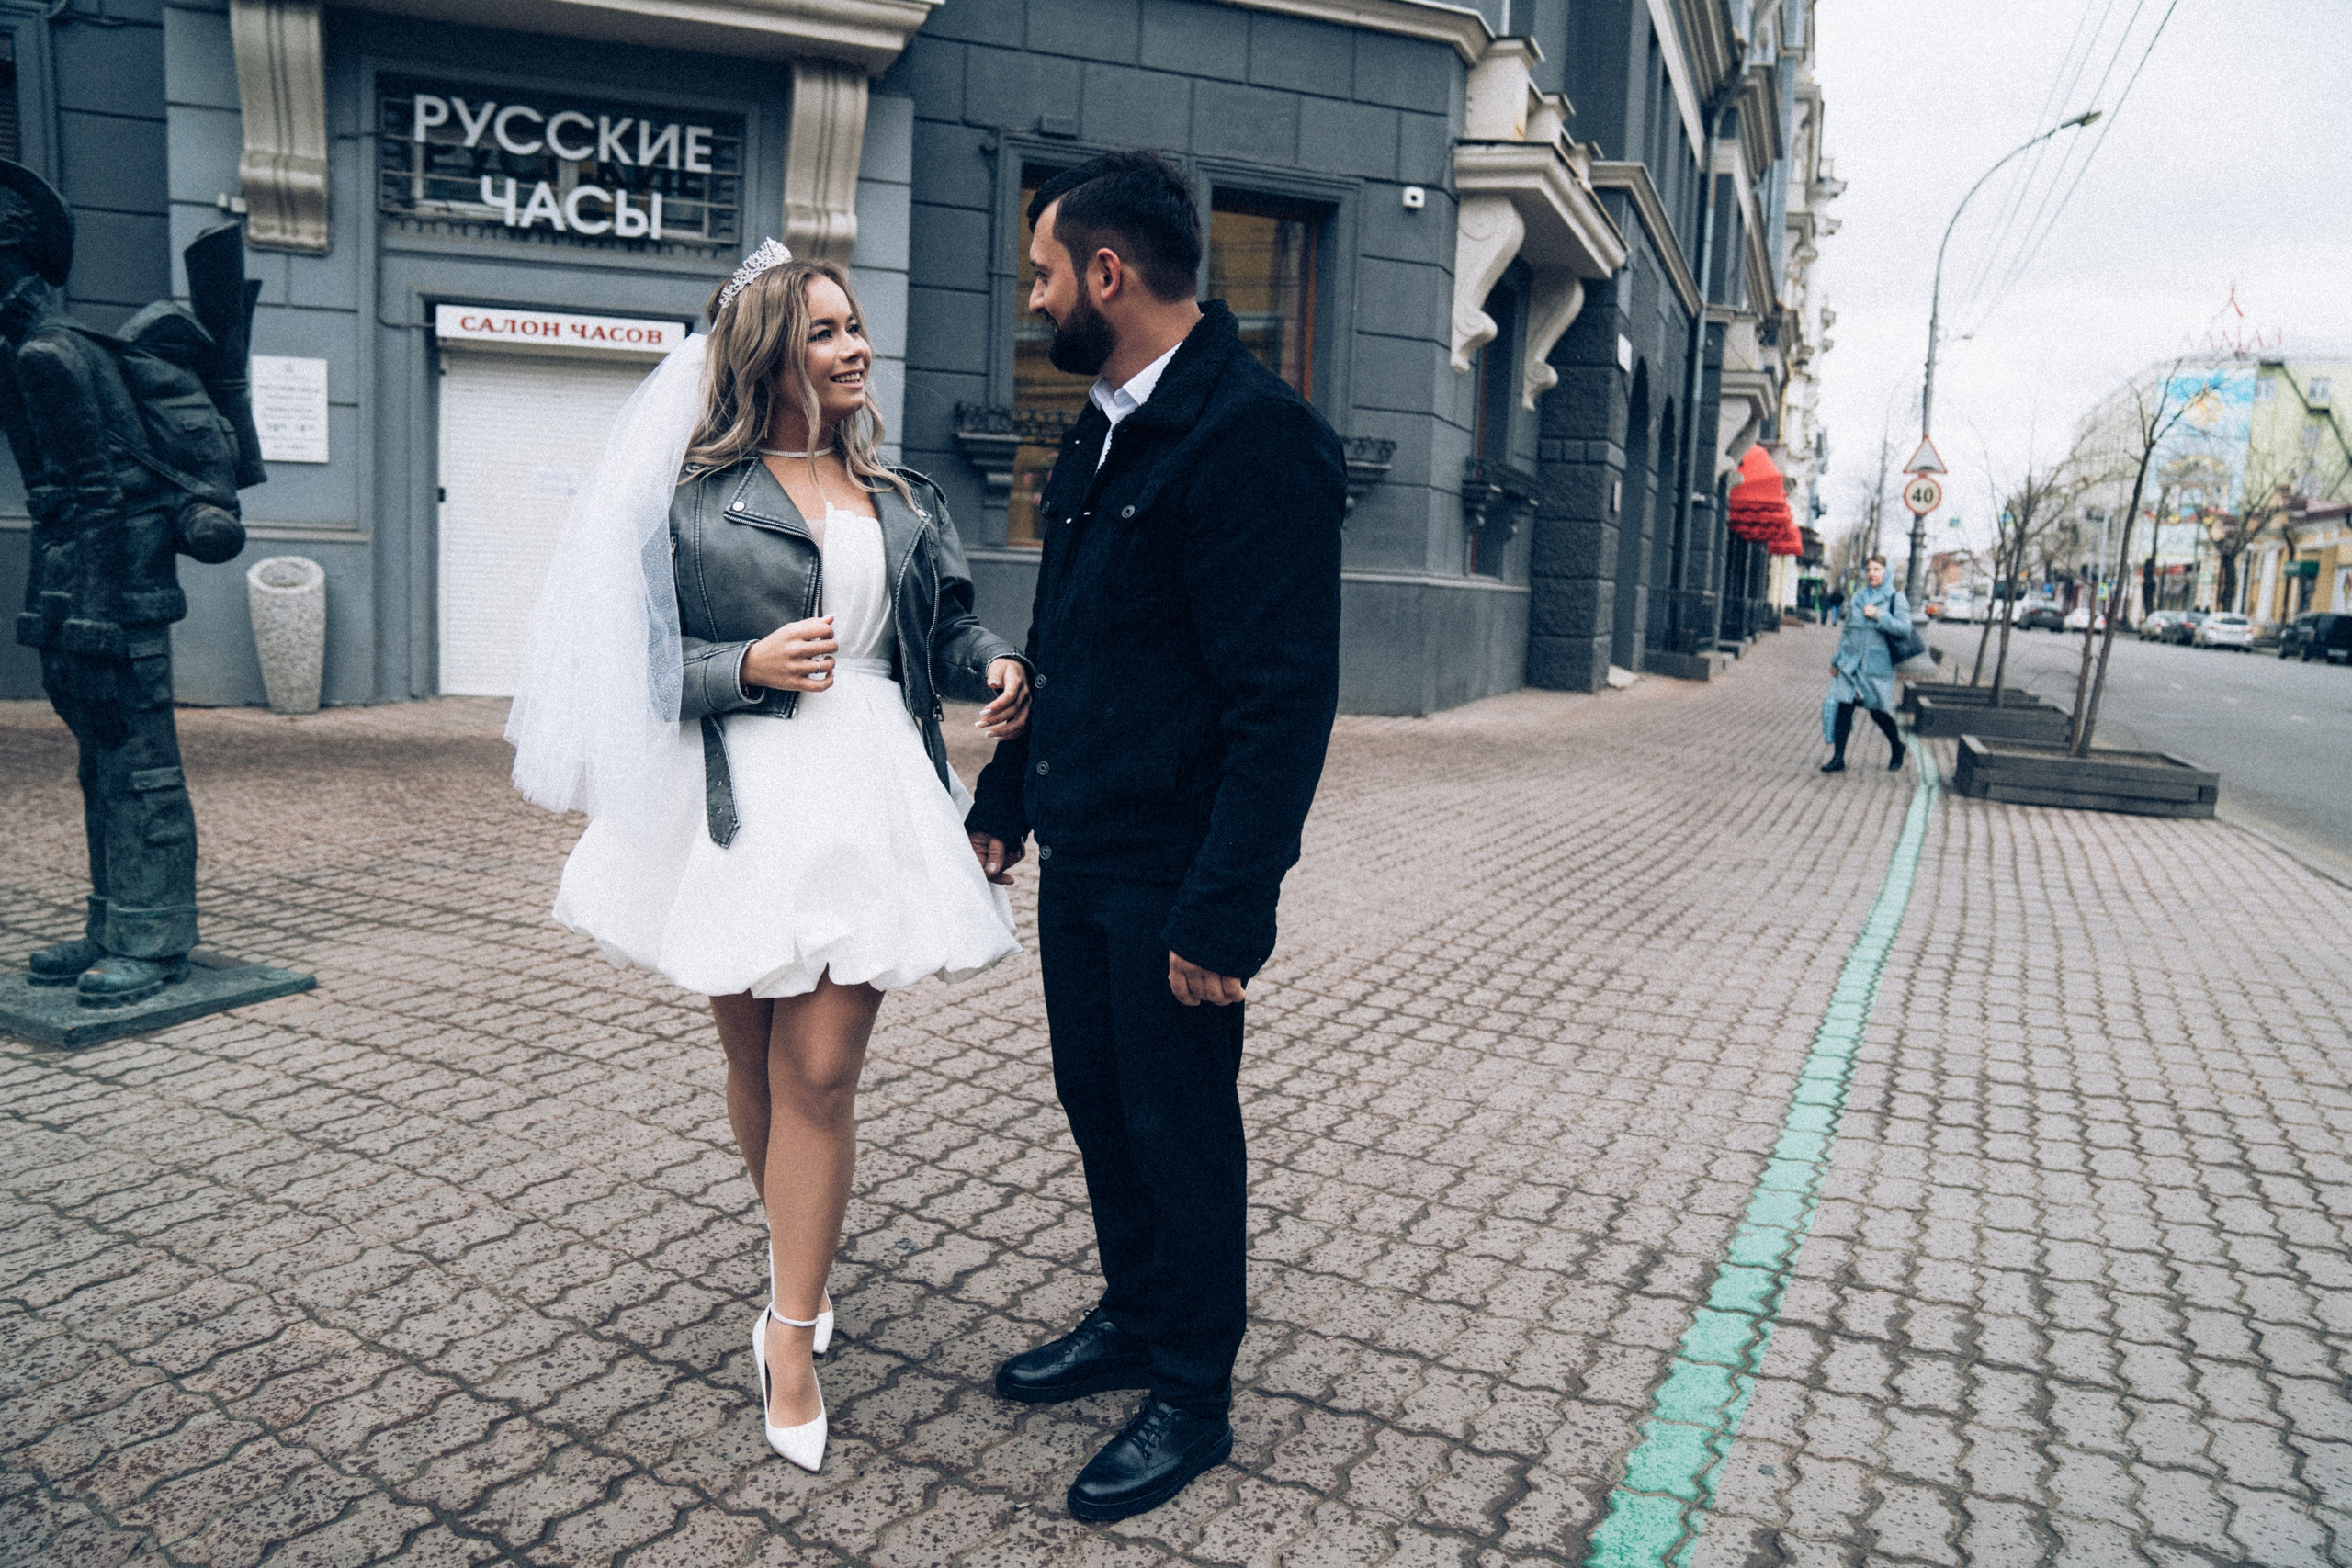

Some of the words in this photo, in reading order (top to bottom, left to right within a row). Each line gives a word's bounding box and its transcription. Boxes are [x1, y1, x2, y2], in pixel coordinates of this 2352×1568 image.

[414, 94, 713, 174] РУССКИЕ
[481, 175, 662, 240] ЧАСЫ
[460, 316, 560, 337] САЛОН
[571, 323, 662, 344] ЧАСОВ
[1911, 488, 1934, 504] 40
